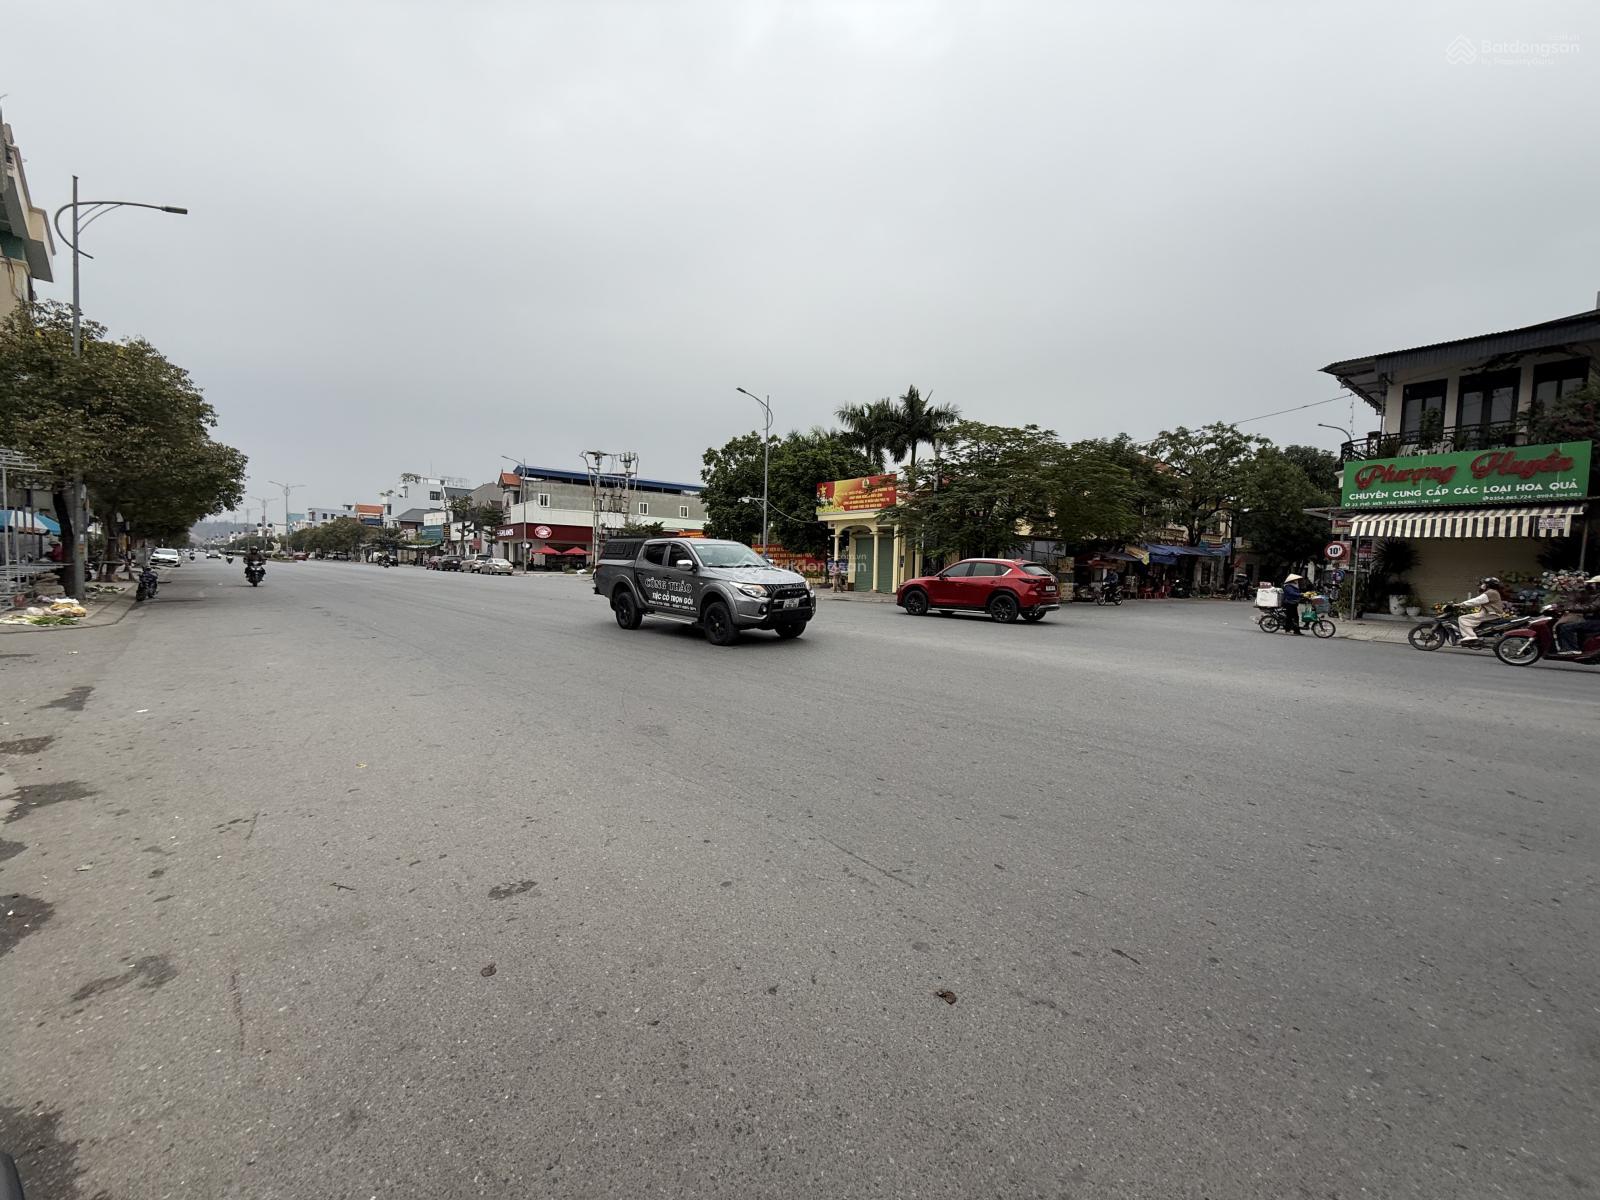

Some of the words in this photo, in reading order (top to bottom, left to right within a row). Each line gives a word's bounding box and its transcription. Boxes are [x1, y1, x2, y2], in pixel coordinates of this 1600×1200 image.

[1349, 490, 1388, 500] CHUYÊN
[1393, 489, 1421, 498] CUNG
[1426, 485, 1449, 496] CẤP
[1454, 484, 1479, 495] CÁC
[1484, 484, 1511, 495] LOẠI
[1516, 483, 1543, 492] HOA
[1549, 478, 1578, 491] QUẢ
